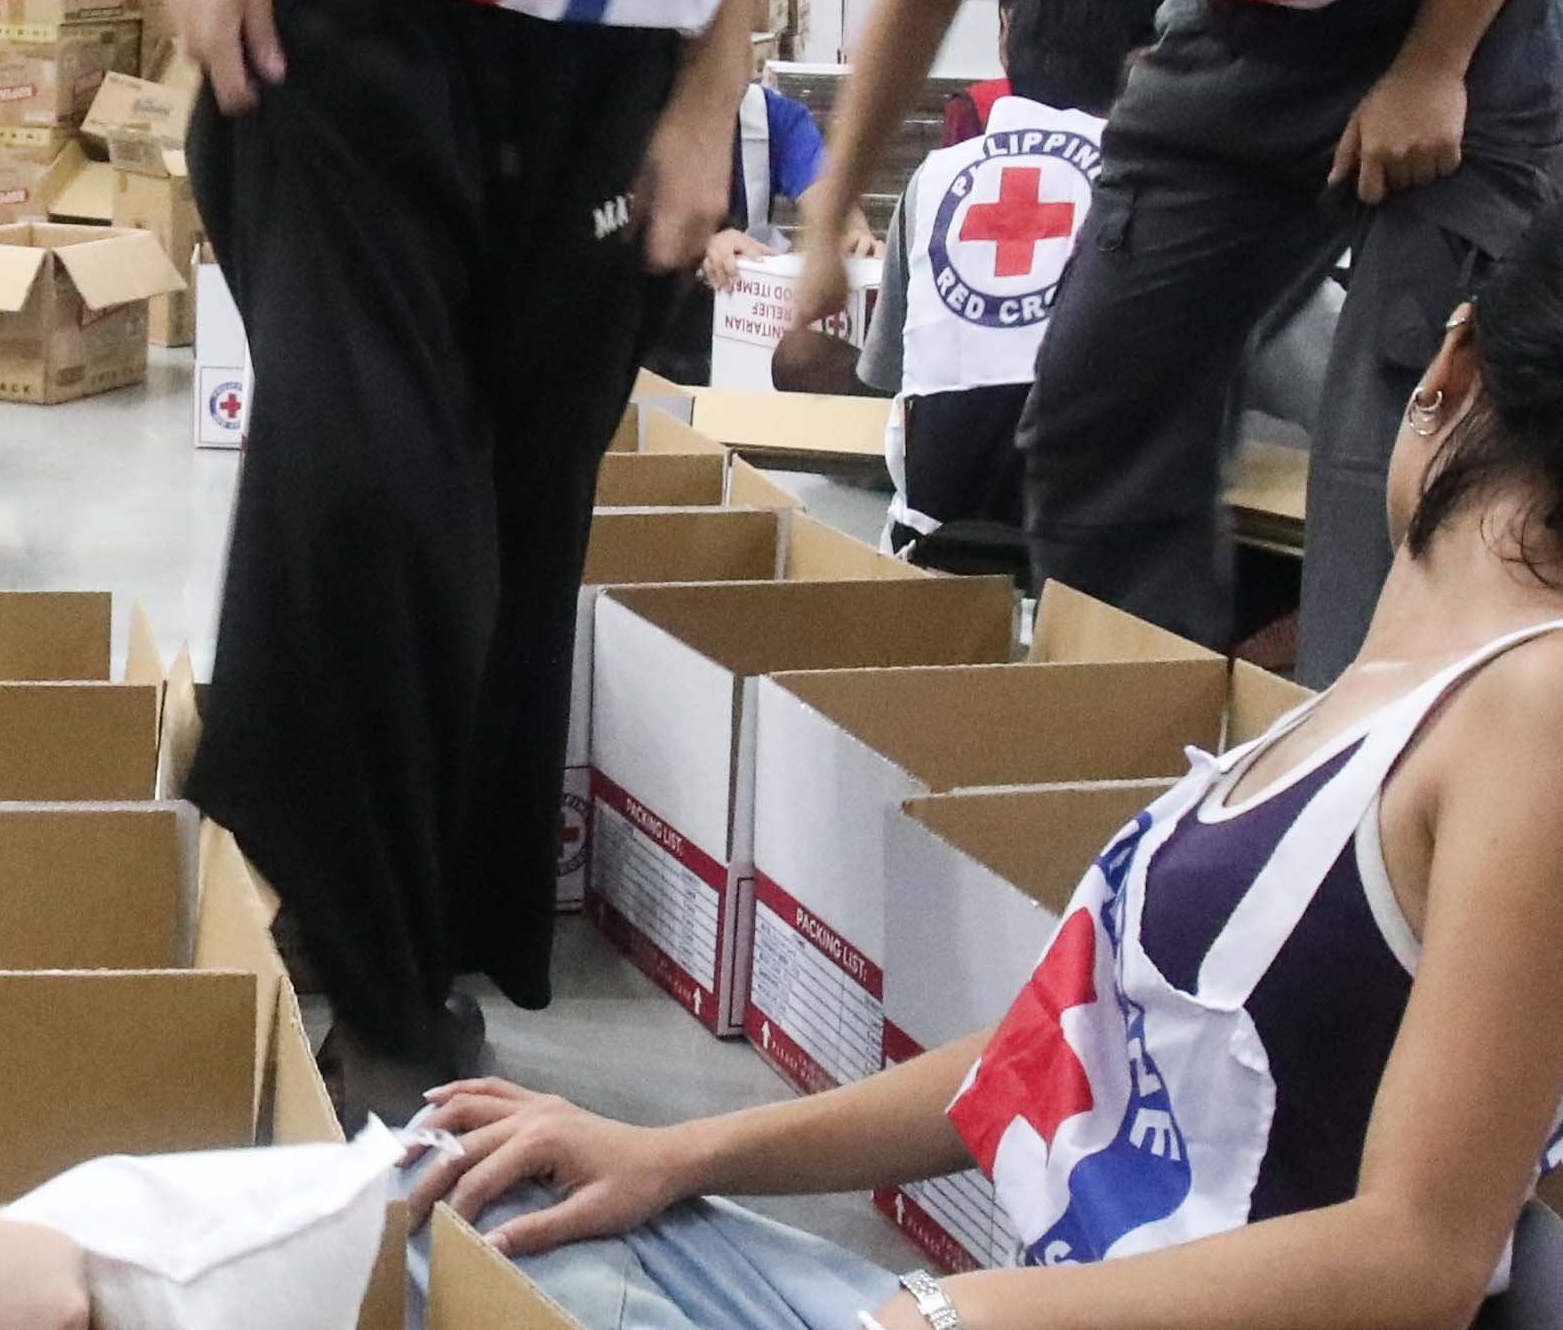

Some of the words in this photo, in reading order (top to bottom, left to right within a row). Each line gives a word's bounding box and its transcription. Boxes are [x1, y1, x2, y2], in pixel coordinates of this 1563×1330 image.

[937, 266, 986, 319] RED
[626, 797, 664, 840] PACKING
[796, 908, 842, 961] PACKING
[842, 944, 868, 983] LIST:
